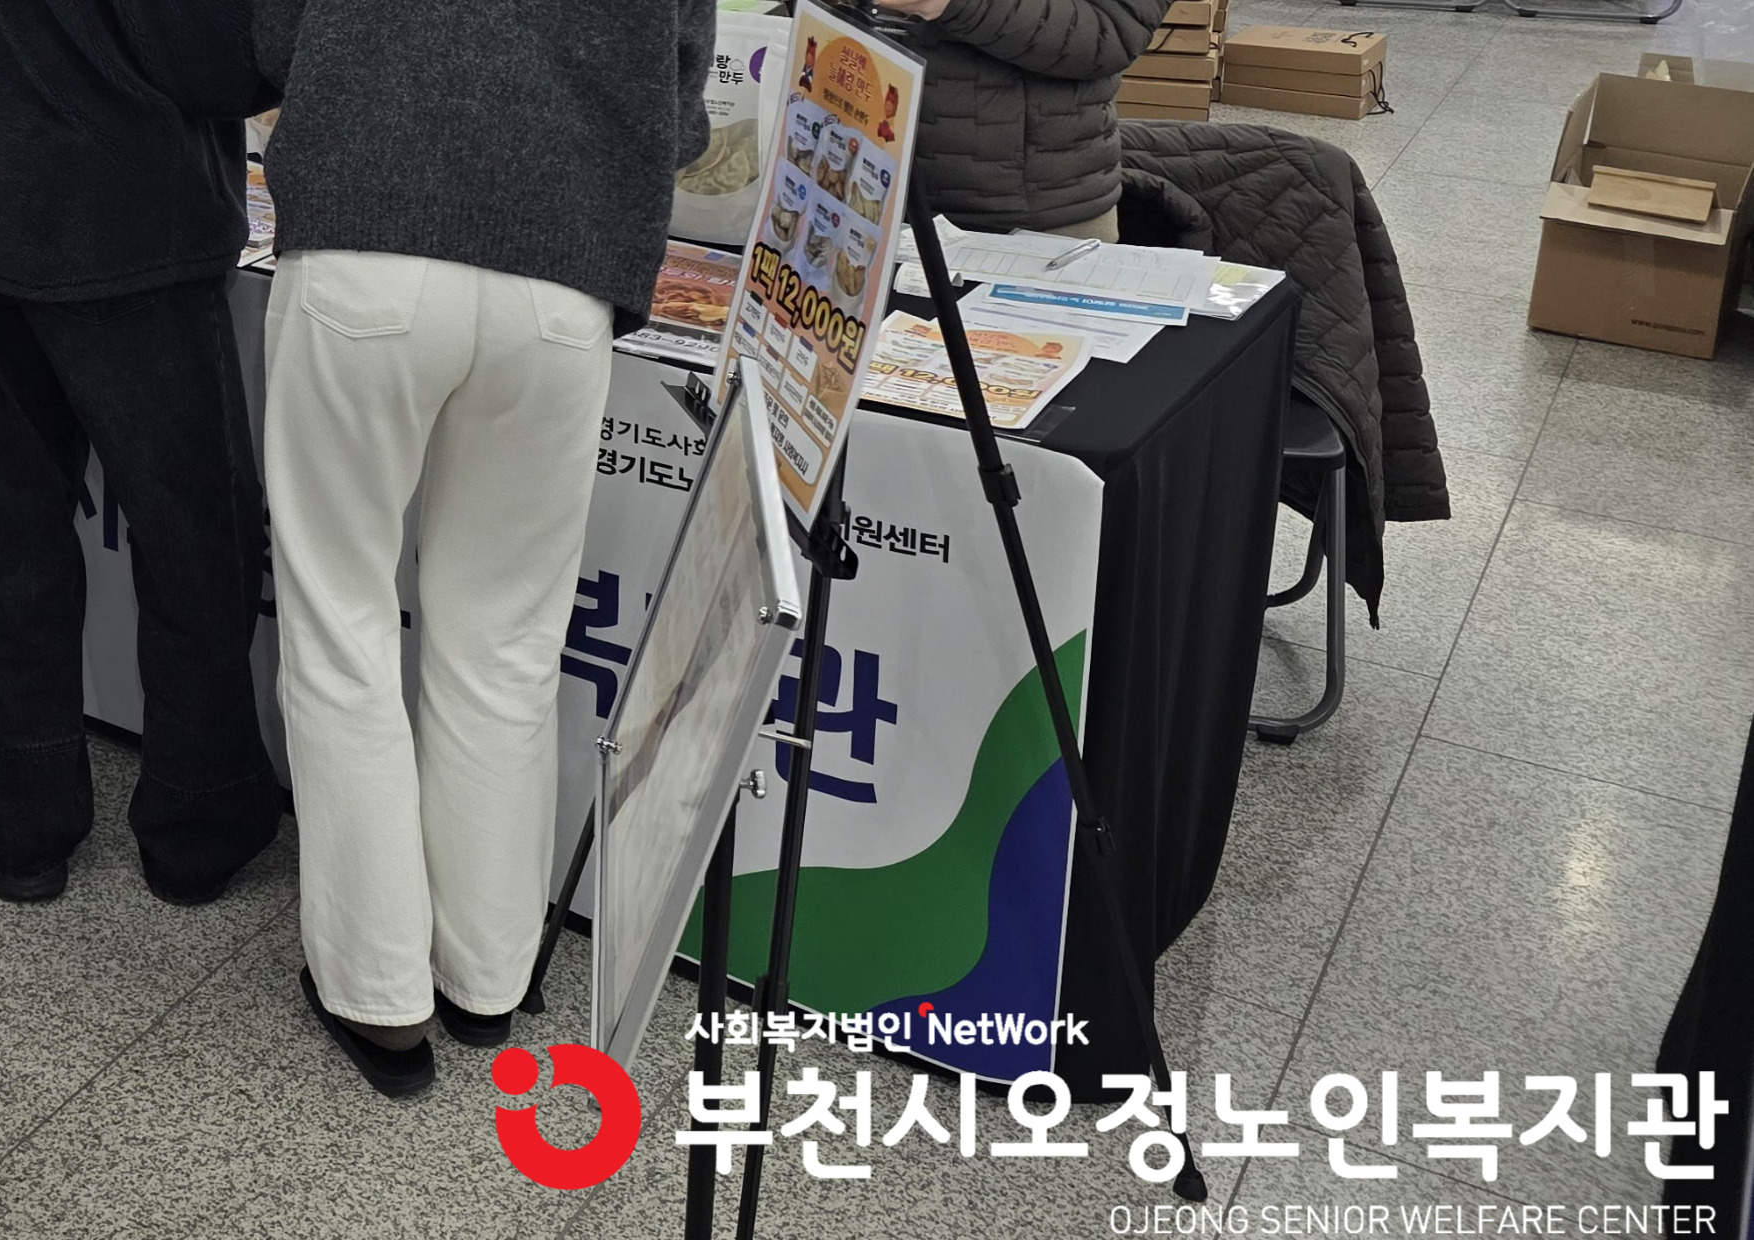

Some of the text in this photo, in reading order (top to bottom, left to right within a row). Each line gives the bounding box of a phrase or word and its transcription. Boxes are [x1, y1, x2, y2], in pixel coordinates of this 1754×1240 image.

[719, 71, 743, 85] 만두
[752, 243, 865, 373] 1팩 12,000원
